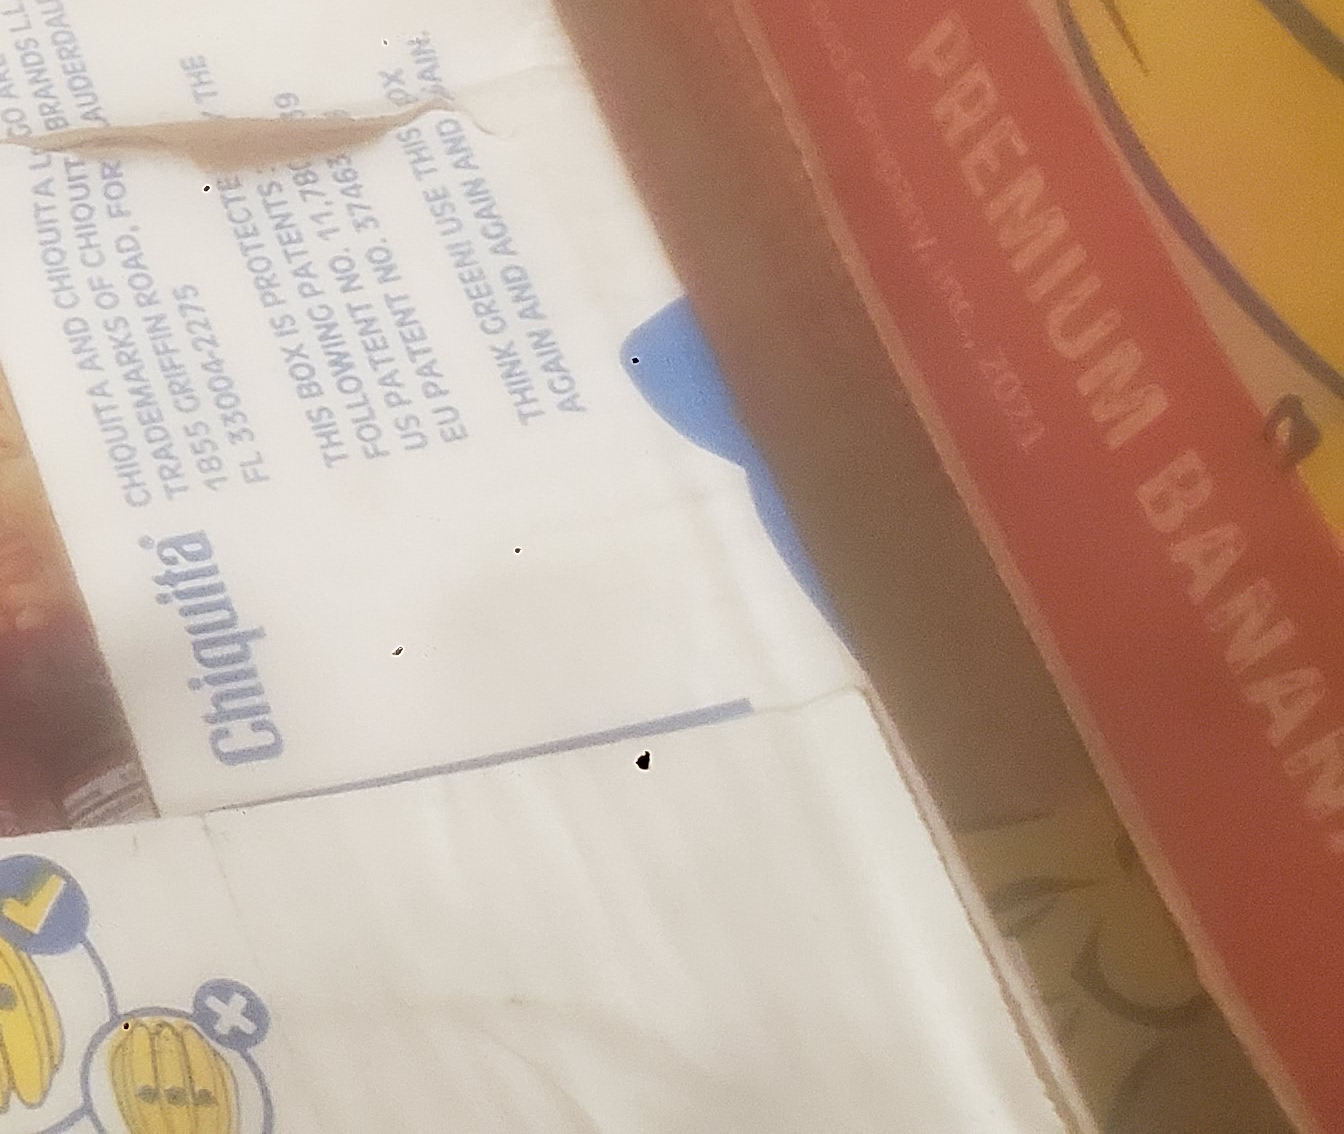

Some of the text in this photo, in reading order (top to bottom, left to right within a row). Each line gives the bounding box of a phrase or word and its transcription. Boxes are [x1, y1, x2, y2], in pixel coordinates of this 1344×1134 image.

[24, 37, 69, 132] BRANDS
[396, 126, 438, 182] THIS
[435, 117, 480, 171] AND
[32, 176, 81, 311] CHIQUITA
[63, 158, 107, 269] CHIQUIT
[423, 186, 463, 237] USE
[461, 177, 519, 257] AGAIN
[89, 271, 121, 311] OF
[178, 53, 349, 468] THIS BOX IS PROTECTE THE
[499, 265, 548, 322] AND
[63, 317, 104, 372] AND
[153, 316, 201, 415] GRIFFIN
[256, 182, 390, 462] FOLLOWING PATENTS
[346, 300, 412, 409] PATENT
[384, 292, 450, 400] PATENT
[103, 314, 190, 501] TRADEMARKS
[170, 284, 271, 485] FL 33004-2275
[489, 341, 546, 426] THINK
[527, 328, 587, 413] AGAIN
[85, 385, 154, 507] CHIQUITA
[191, 421, 229, 492] 1855
[394, 416, 429, 453] US
[432, 406, 469, 445] EU
[909, 9, 1171, 452] PREMIUM
[1135, 449, 1344, 856] BANAN
[139, 529, 284, 767] Chiquita
